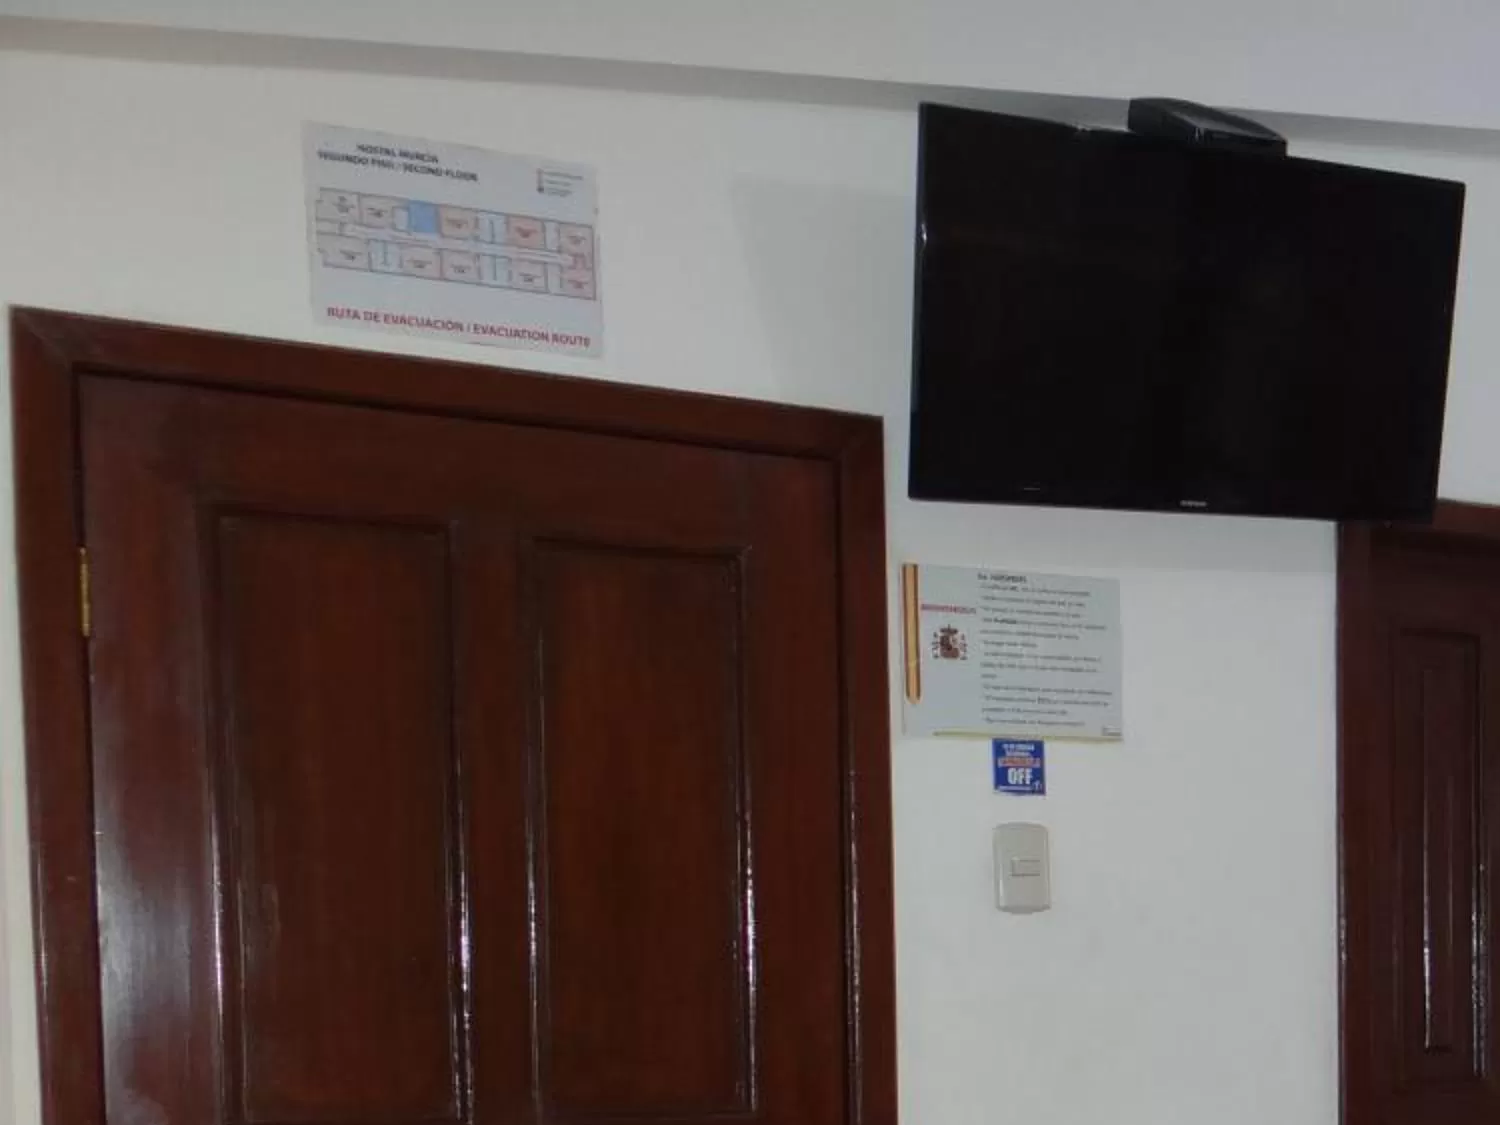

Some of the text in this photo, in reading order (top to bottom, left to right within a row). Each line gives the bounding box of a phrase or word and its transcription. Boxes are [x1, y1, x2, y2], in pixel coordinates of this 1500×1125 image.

[327, 306, 361, 321] RUTA
[363, 310, 381, 324] DE
[473, 323, 550, 344] EVACUATION
[551, 332, 592, 348] ROUTE
[1007, 767, 1033, 785] OFF
